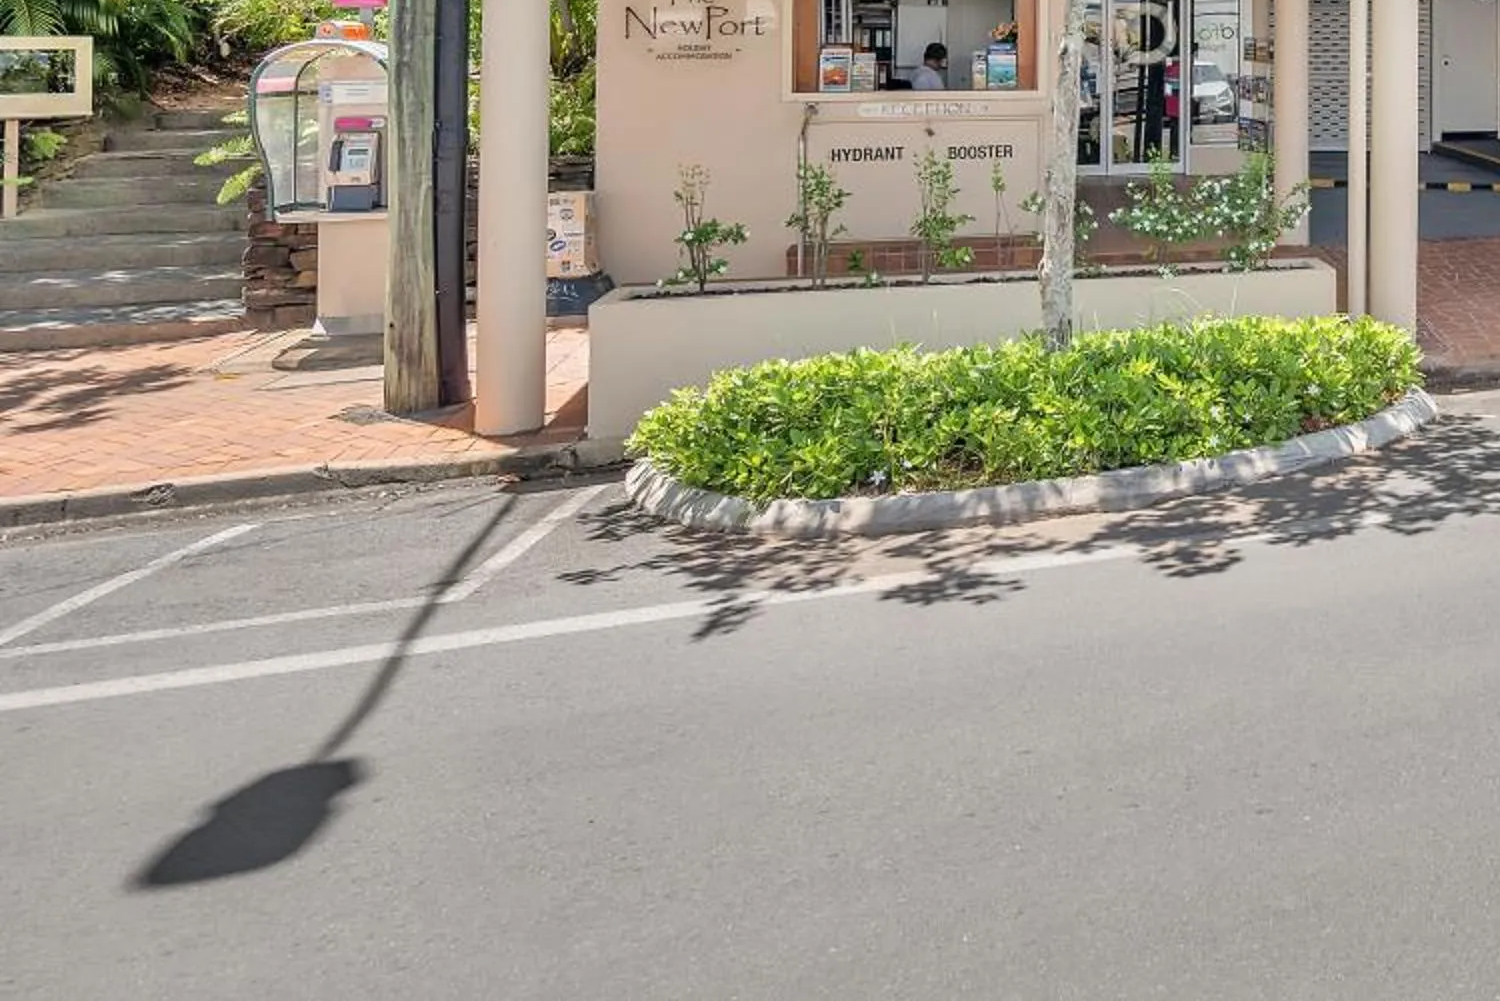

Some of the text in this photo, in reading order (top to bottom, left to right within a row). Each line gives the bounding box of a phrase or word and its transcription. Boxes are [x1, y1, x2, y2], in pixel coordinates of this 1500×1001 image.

[624, 5, 766, 40] NewPort
[831, 144, 1013, 162] HYDRANT BOOSTER
